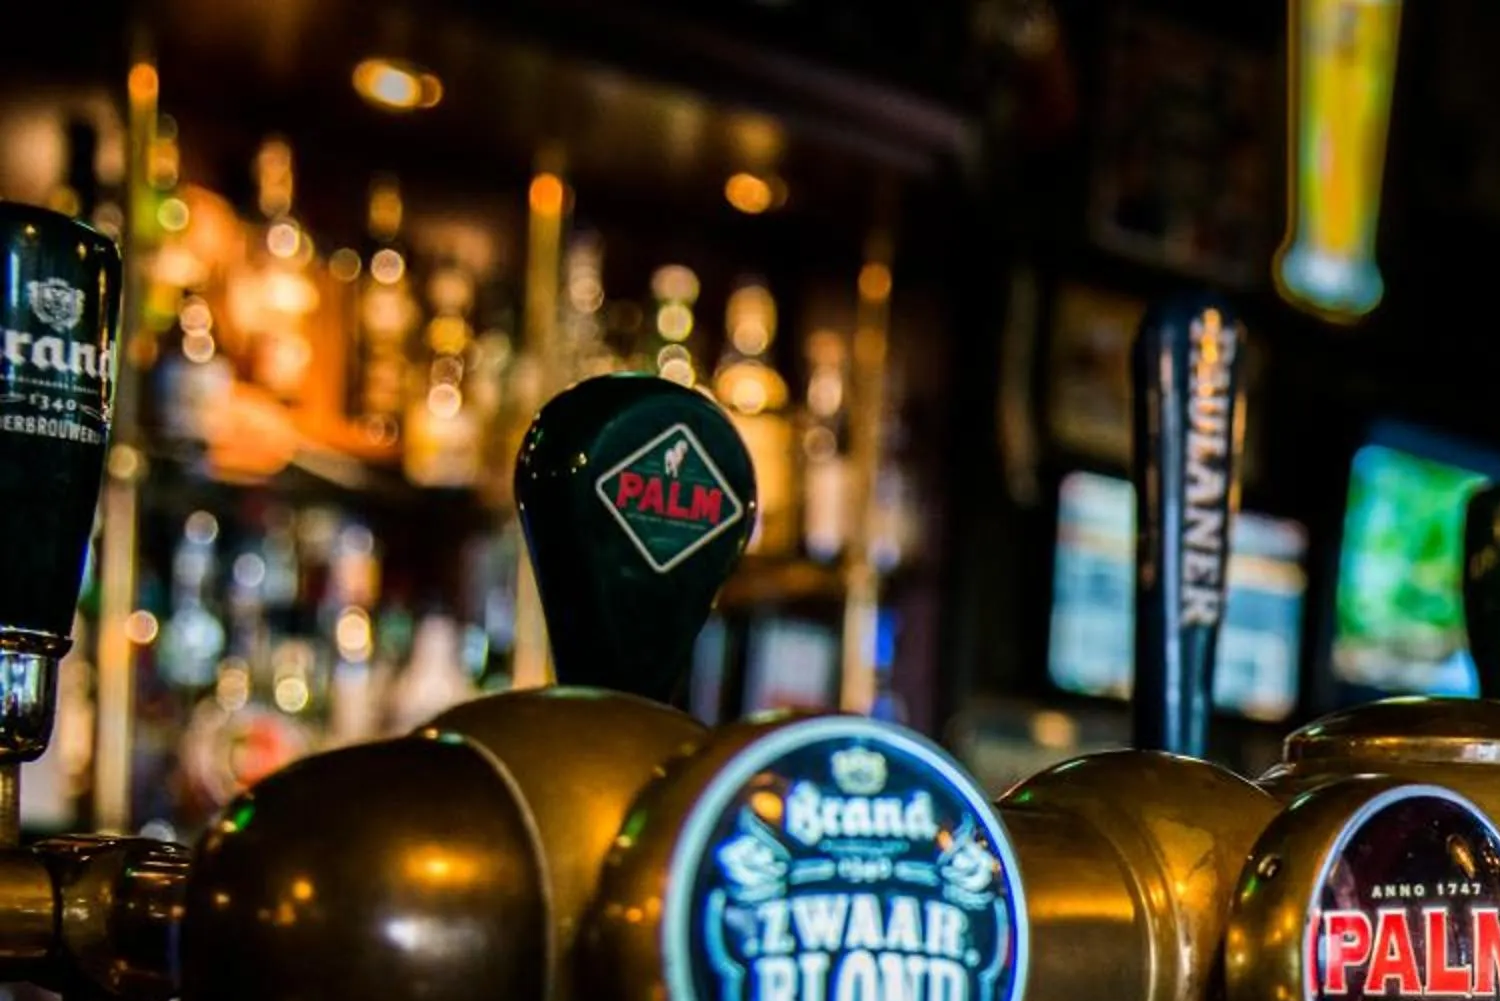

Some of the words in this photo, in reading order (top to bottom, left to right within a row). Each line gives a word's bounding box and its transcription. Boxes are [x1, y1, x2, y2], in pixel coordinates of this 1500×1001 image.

[615, 471, 723, 525] PALM
[785, 780, 938, 845] Brand
[1371, 884, 1425, 898] ANNO
[1437, 883, 1482, 896] 1747
[757, 893, 967, 954] ZWAAR
